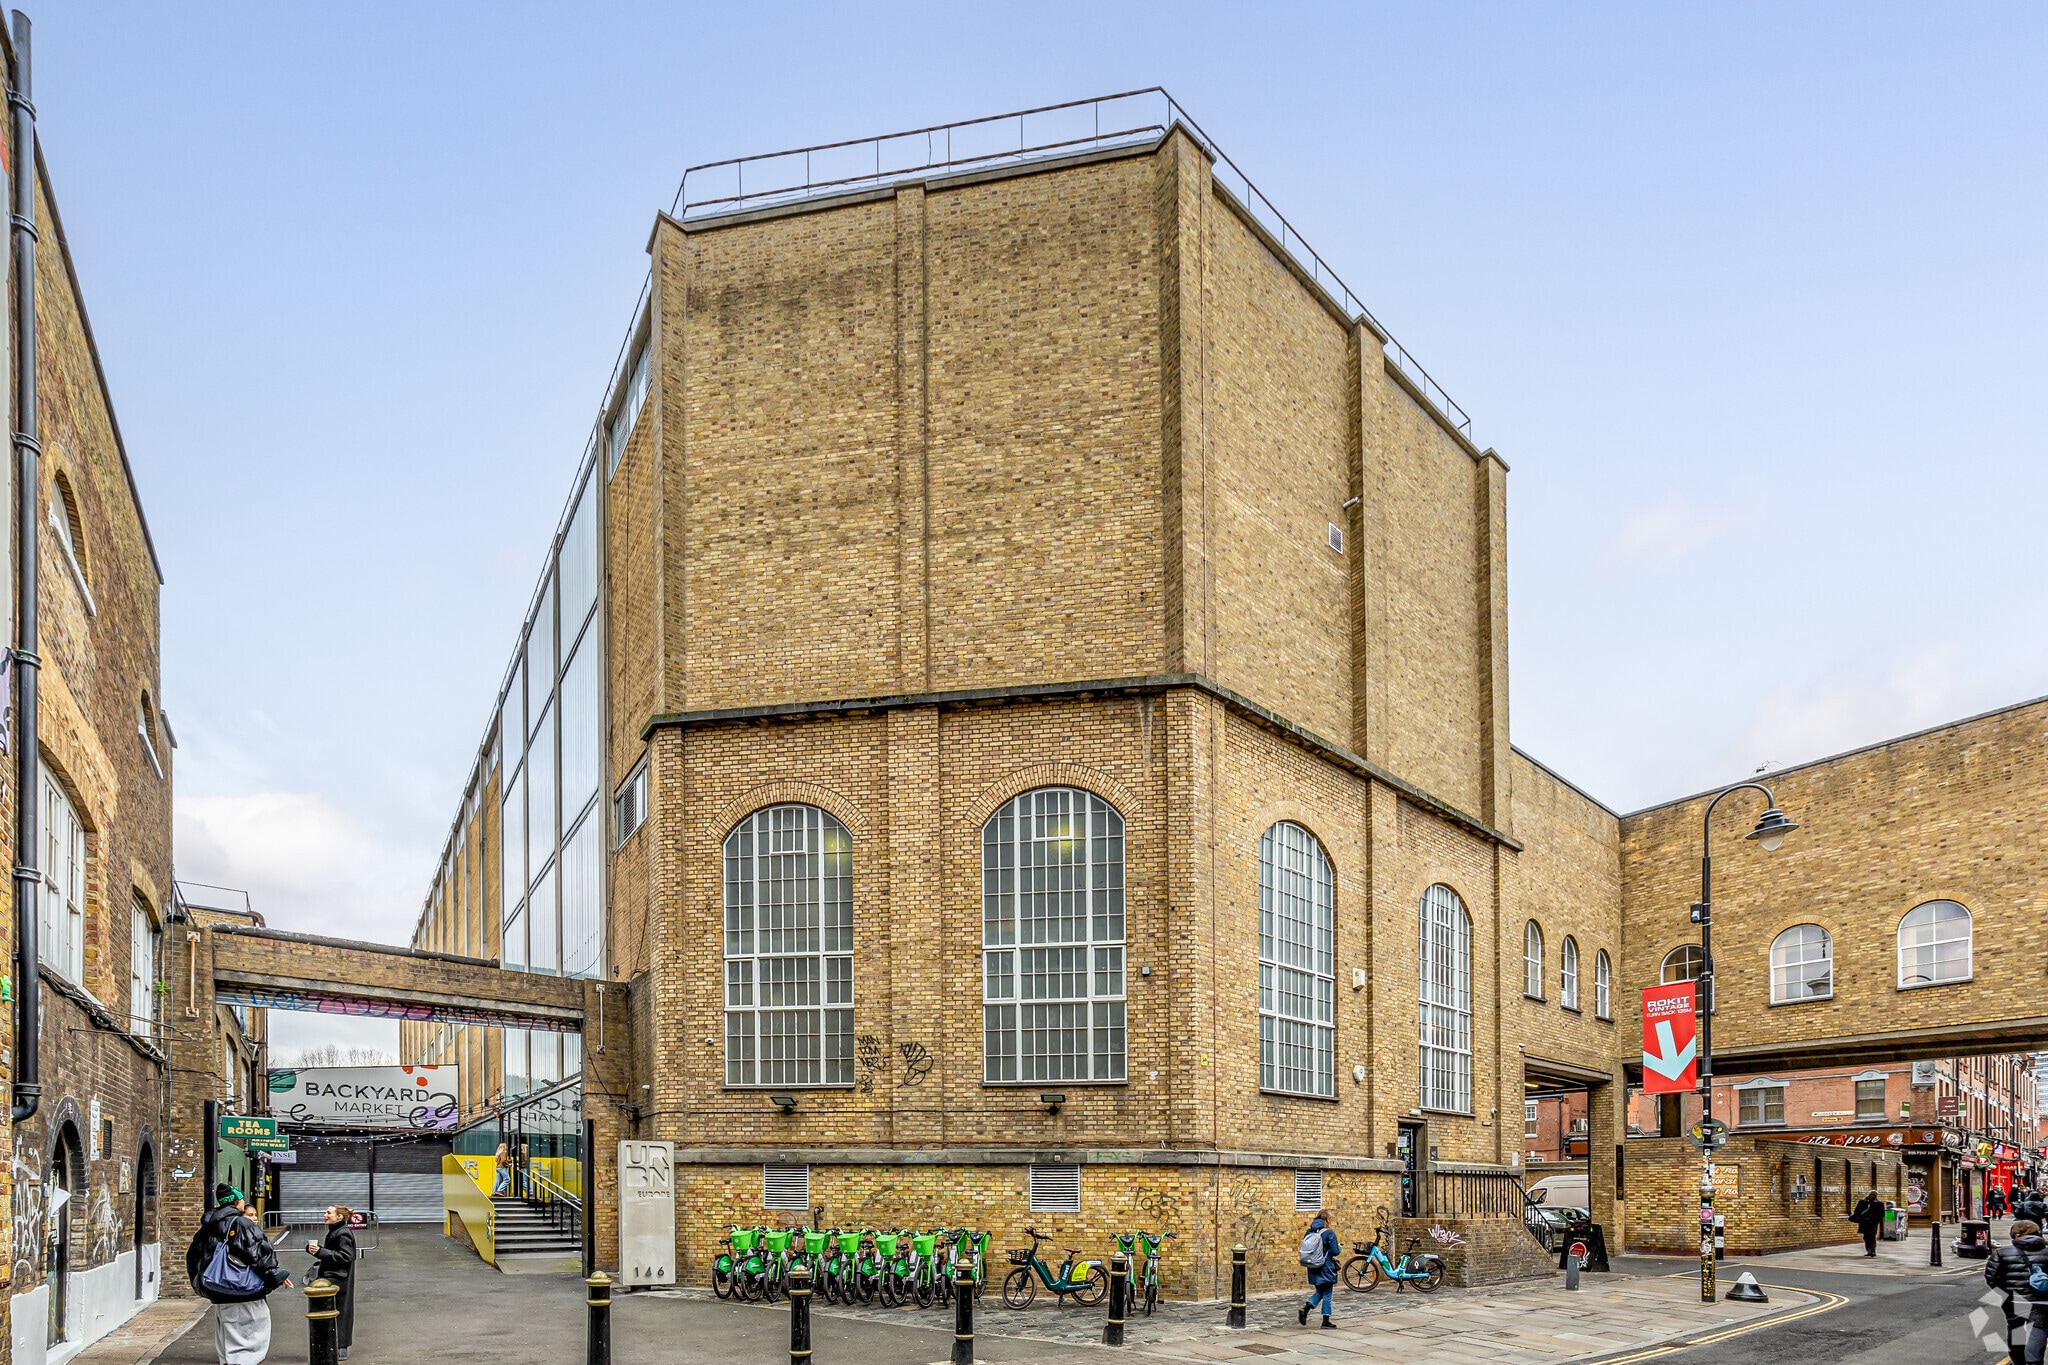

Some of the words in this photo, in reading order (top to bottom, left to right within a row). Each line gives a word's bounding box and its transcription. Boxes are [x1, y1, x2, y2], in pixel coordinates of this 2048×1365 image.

[1647, 996, 1690, 1008] ROKIT
[1648, 1003, 1689, 1013] VINTAGE
[305, 1082, 429, 1102] BACKYARD
[334, 1101, 403, 1114] MARKET
[238, 1120, 260, 1128] TEA
[227, 1126, 271, 1136] ROOMS
[1834, 1134, 1880, 1147] Spice
[634, 1266, 665, 1277] 146
